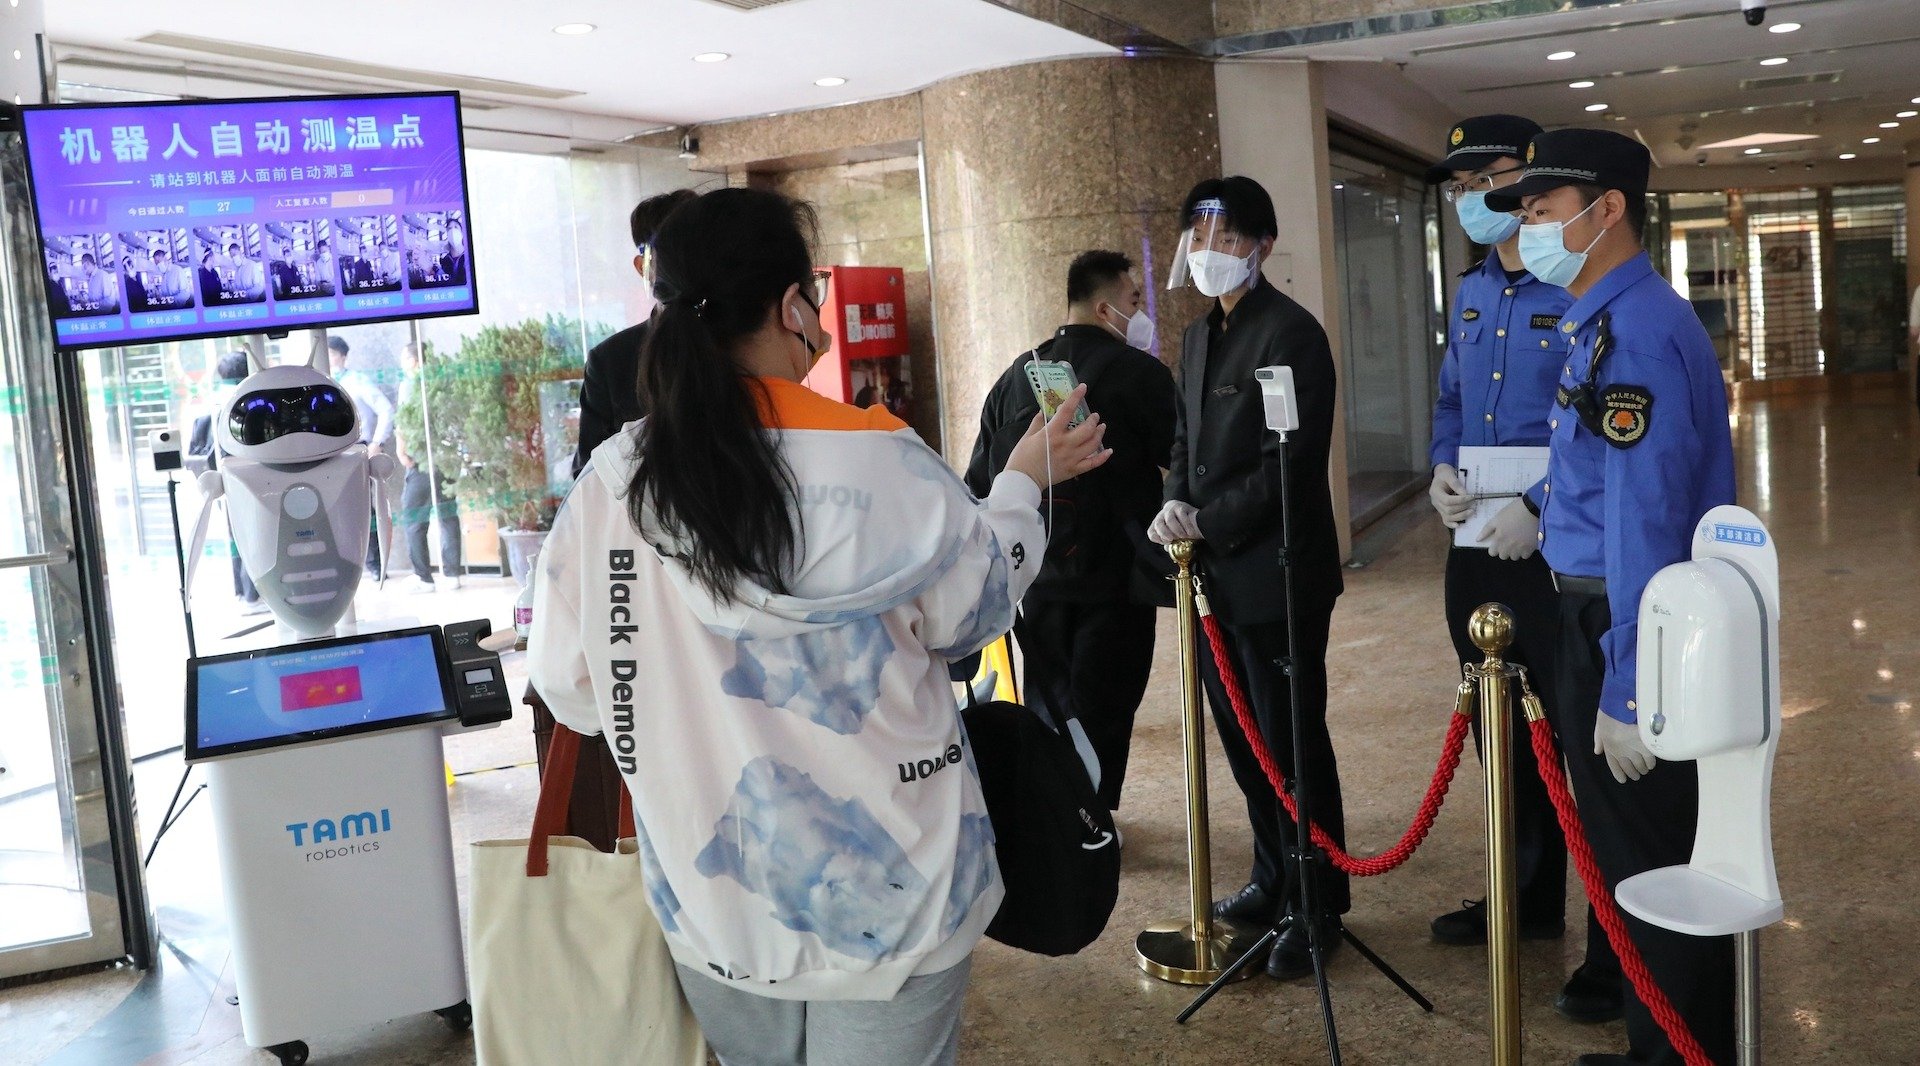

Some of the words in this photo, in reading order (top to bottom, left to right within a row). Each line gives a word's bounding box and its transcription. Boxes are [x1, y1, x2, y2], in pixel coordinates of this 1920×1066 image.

[59, 114, 424, 165] 机器人自动测温点
[150, 164, 354, 189] 请站到机器人面前自动测温
[128, 205, 184, 217] 今日通过人数
[217, 201, 230, 213] 27
[423, 291, 455, 301] 体温正常
[289, 302, 322, 313] 体温正常
[357, 297, 390, 308] 体温正常
[219, 308, 253, 319] 体温正常
[147, 315, 182, 325] 体温正常
[71, 321, 107, 332] 体温正常
[1717, 528, 1761, 543] 手部清洁器
[608, 549, 638, 645] Black
[610, 660, 637, 775] Demon
[286, 809, 391, 846] TAMI
[305, 840, 380, 862] robotics
